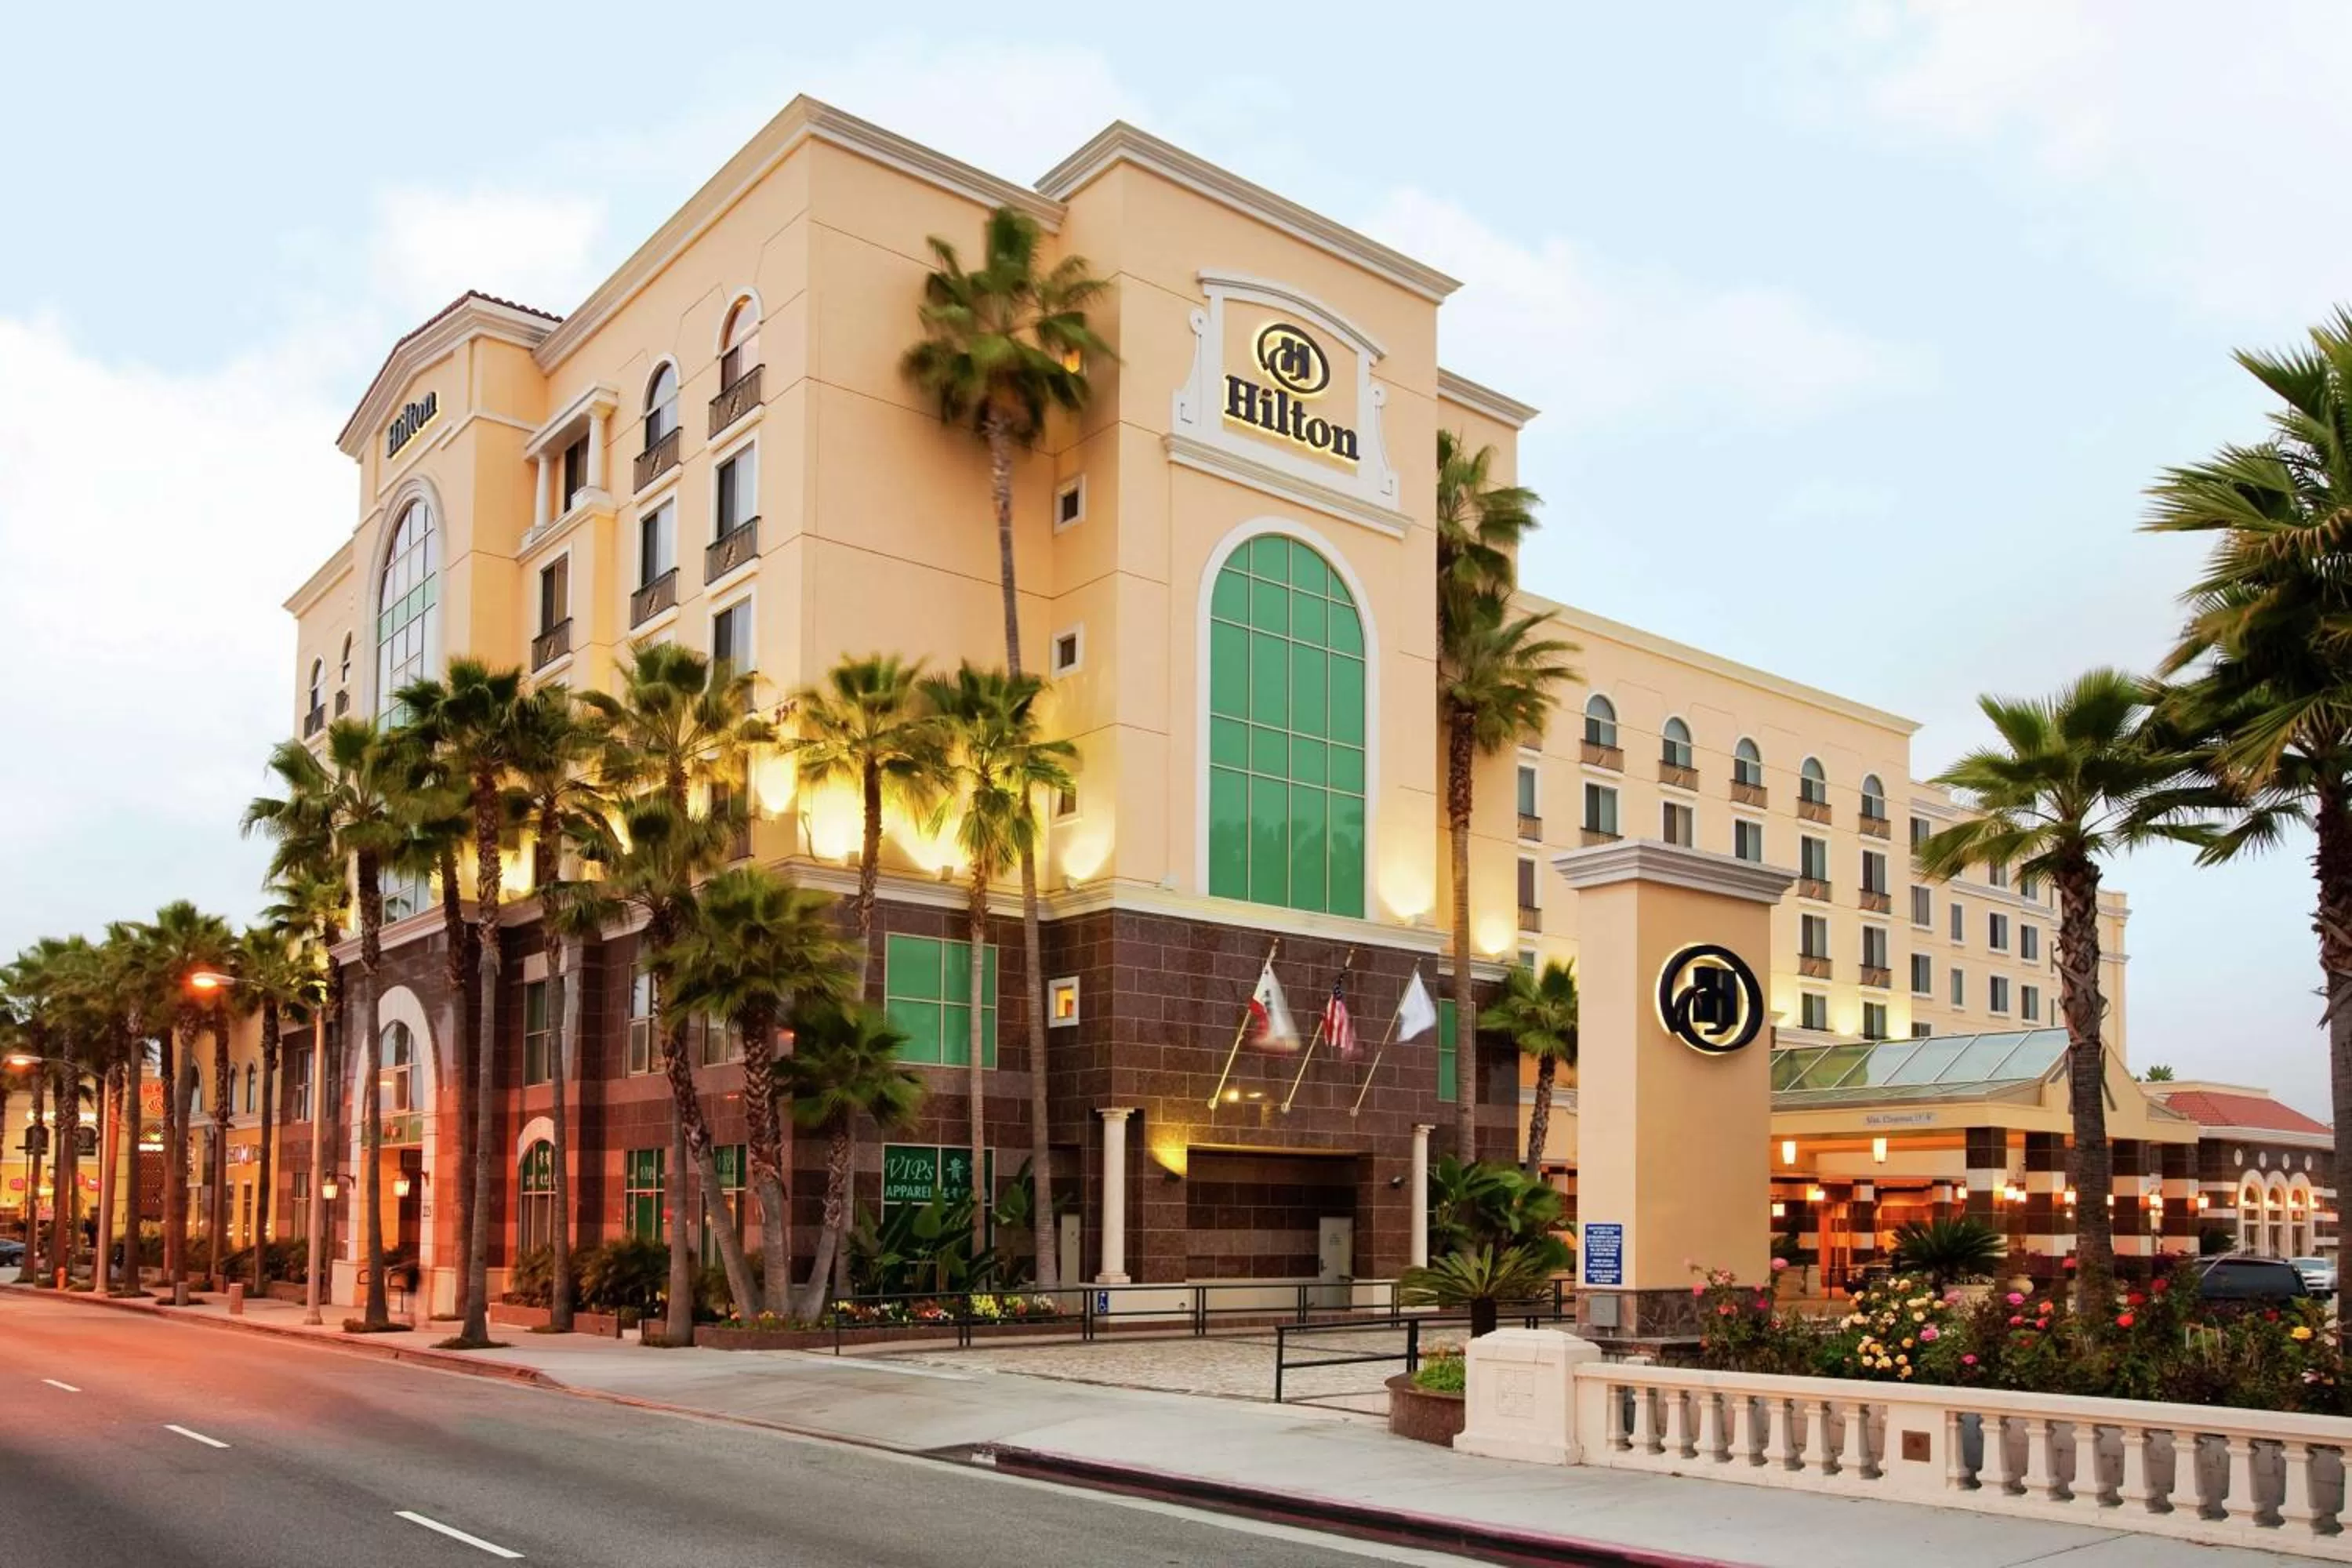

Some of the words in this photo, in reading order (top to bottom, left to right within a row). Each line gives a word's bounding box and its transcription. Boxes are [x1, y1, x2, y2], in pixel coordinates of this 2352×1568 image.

[387, 391, 438, 459] Hilton
[1223, 374, 1361, 462] Hilton
[886, 1155, 935, 1181] VIPs
